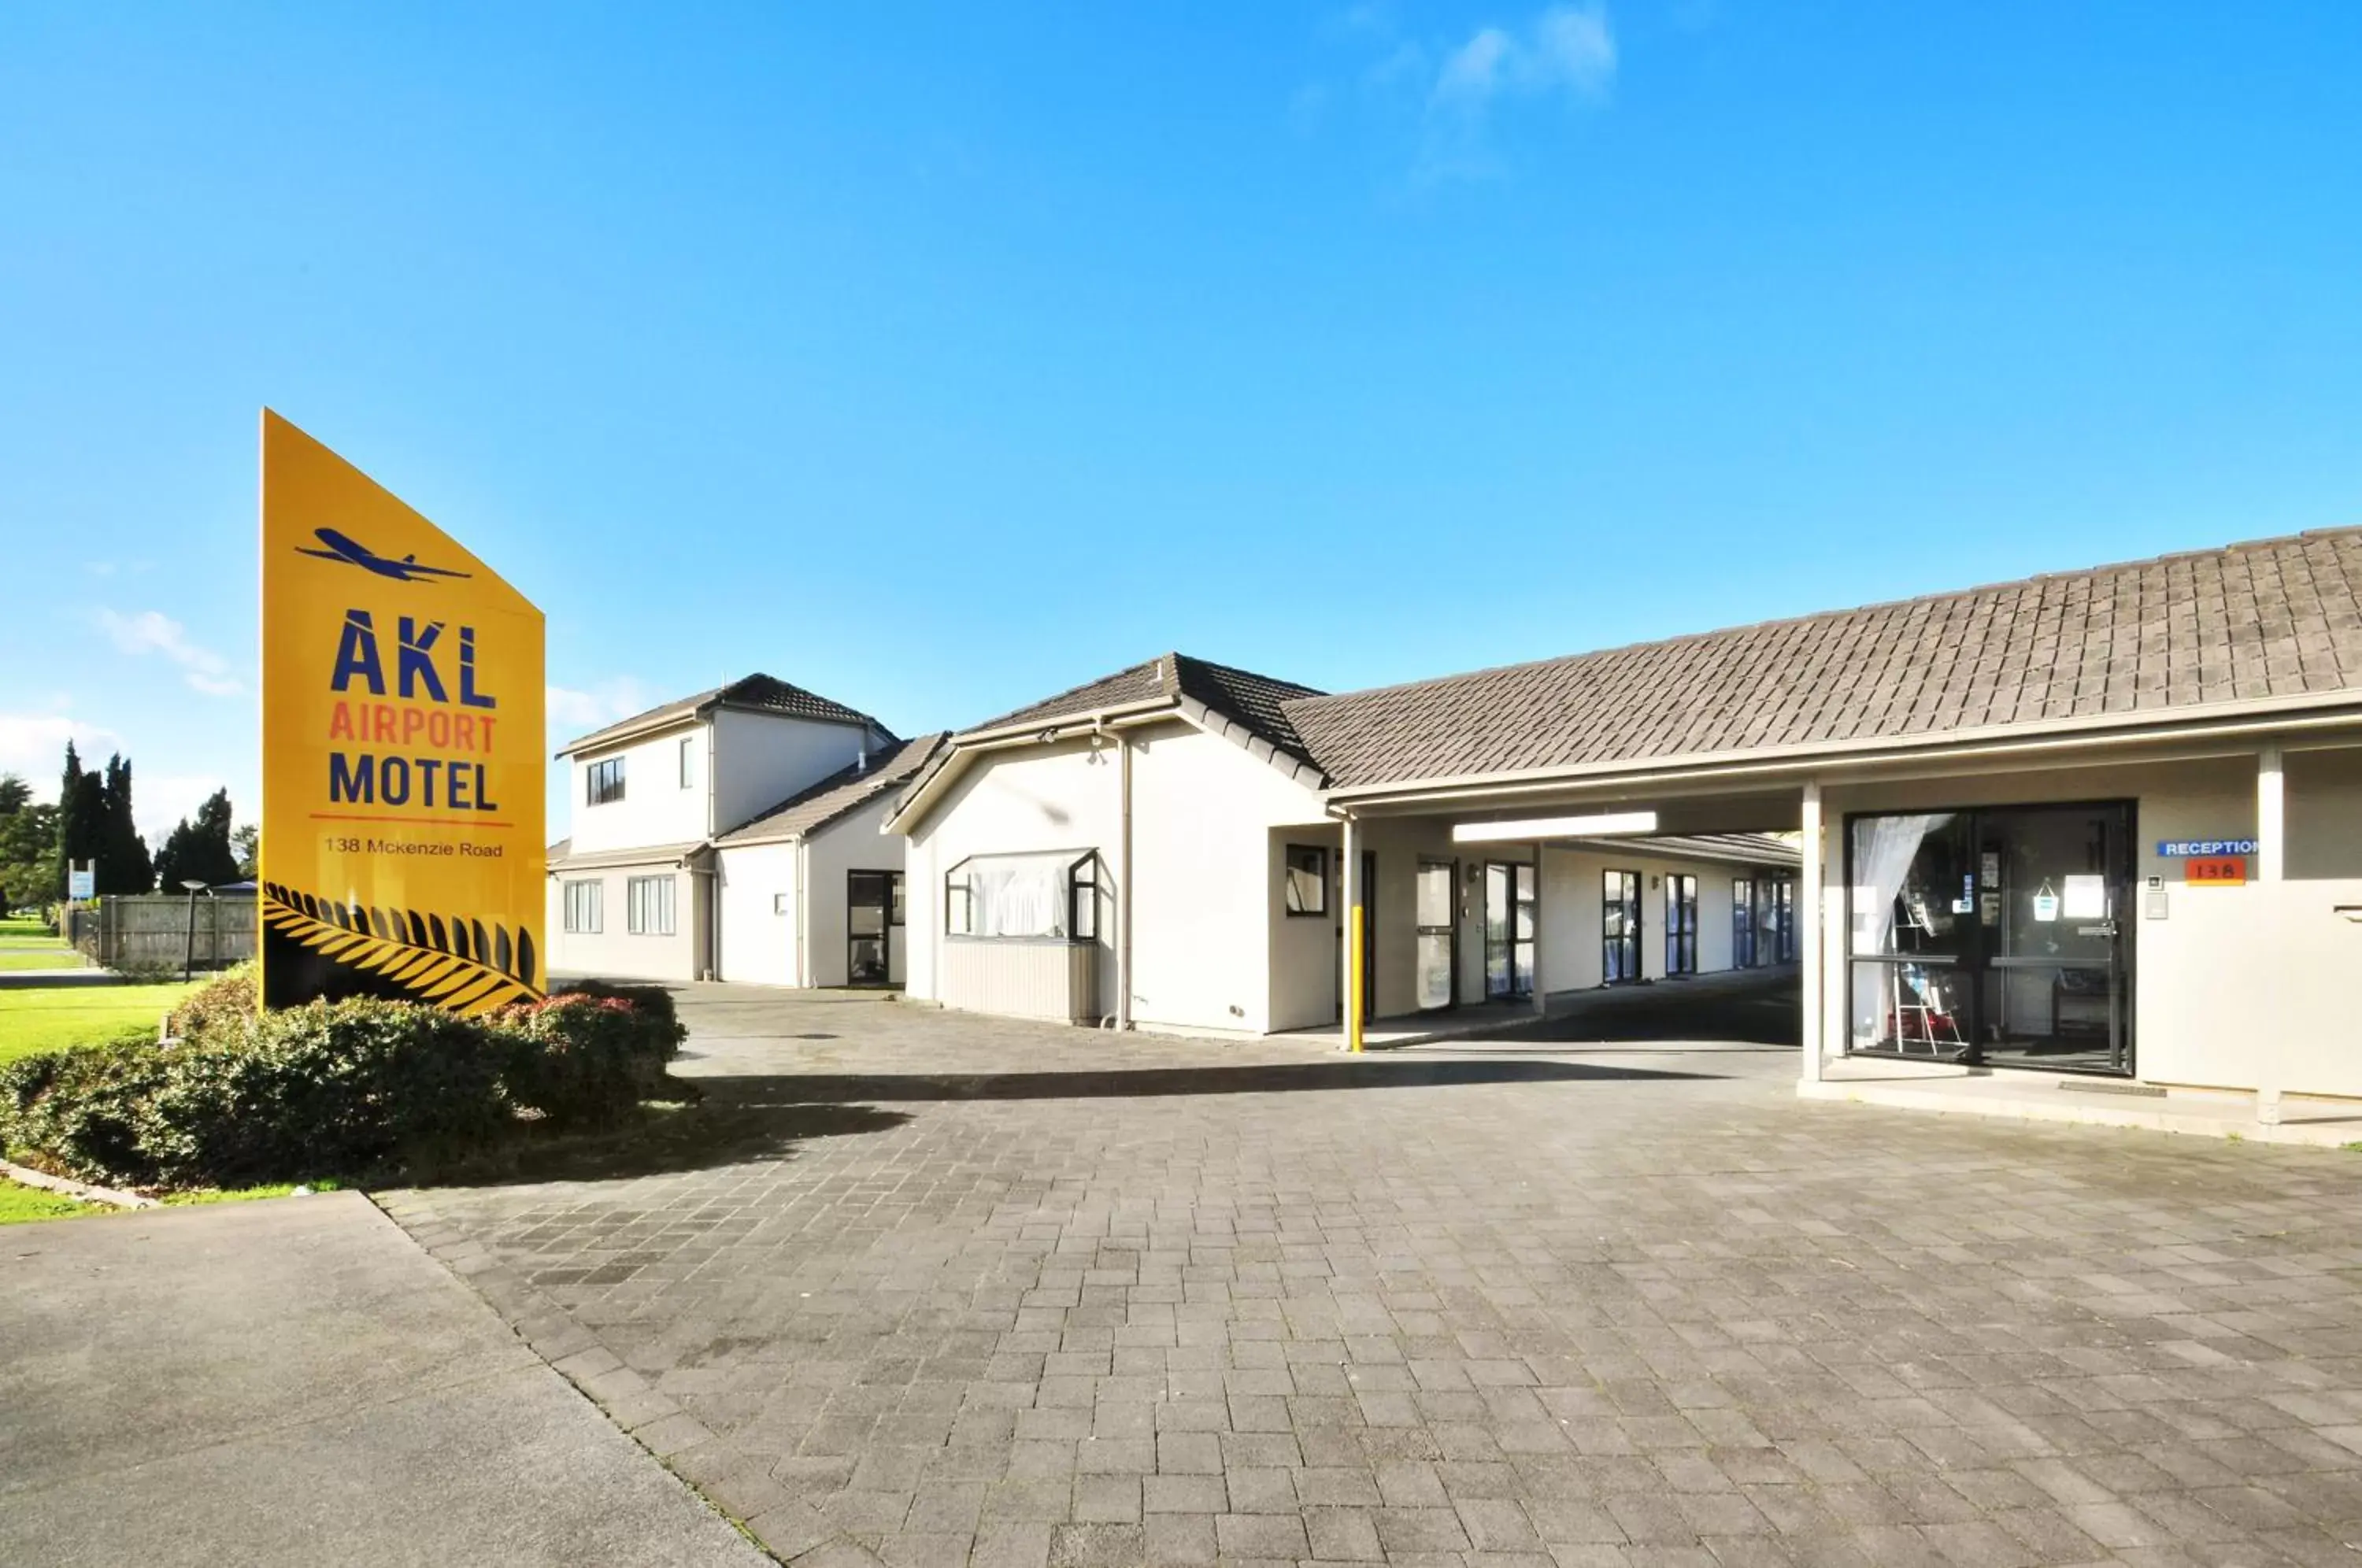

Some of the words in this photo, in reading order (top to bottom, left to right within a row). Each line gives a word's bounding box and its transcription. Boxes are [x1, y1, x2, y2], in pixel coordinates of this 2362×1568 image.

[331, 608, 496, 708] AKL
[330, 701, 497, 753] AIRPORT
[330, 752, 497, 811] MOTEL
[325, 838, 360, 852] 138
[367, 839, 454, 856] Mckenzie
[459, 842, 502, 857] Road
[2196, 864, 2234, 878] 138
